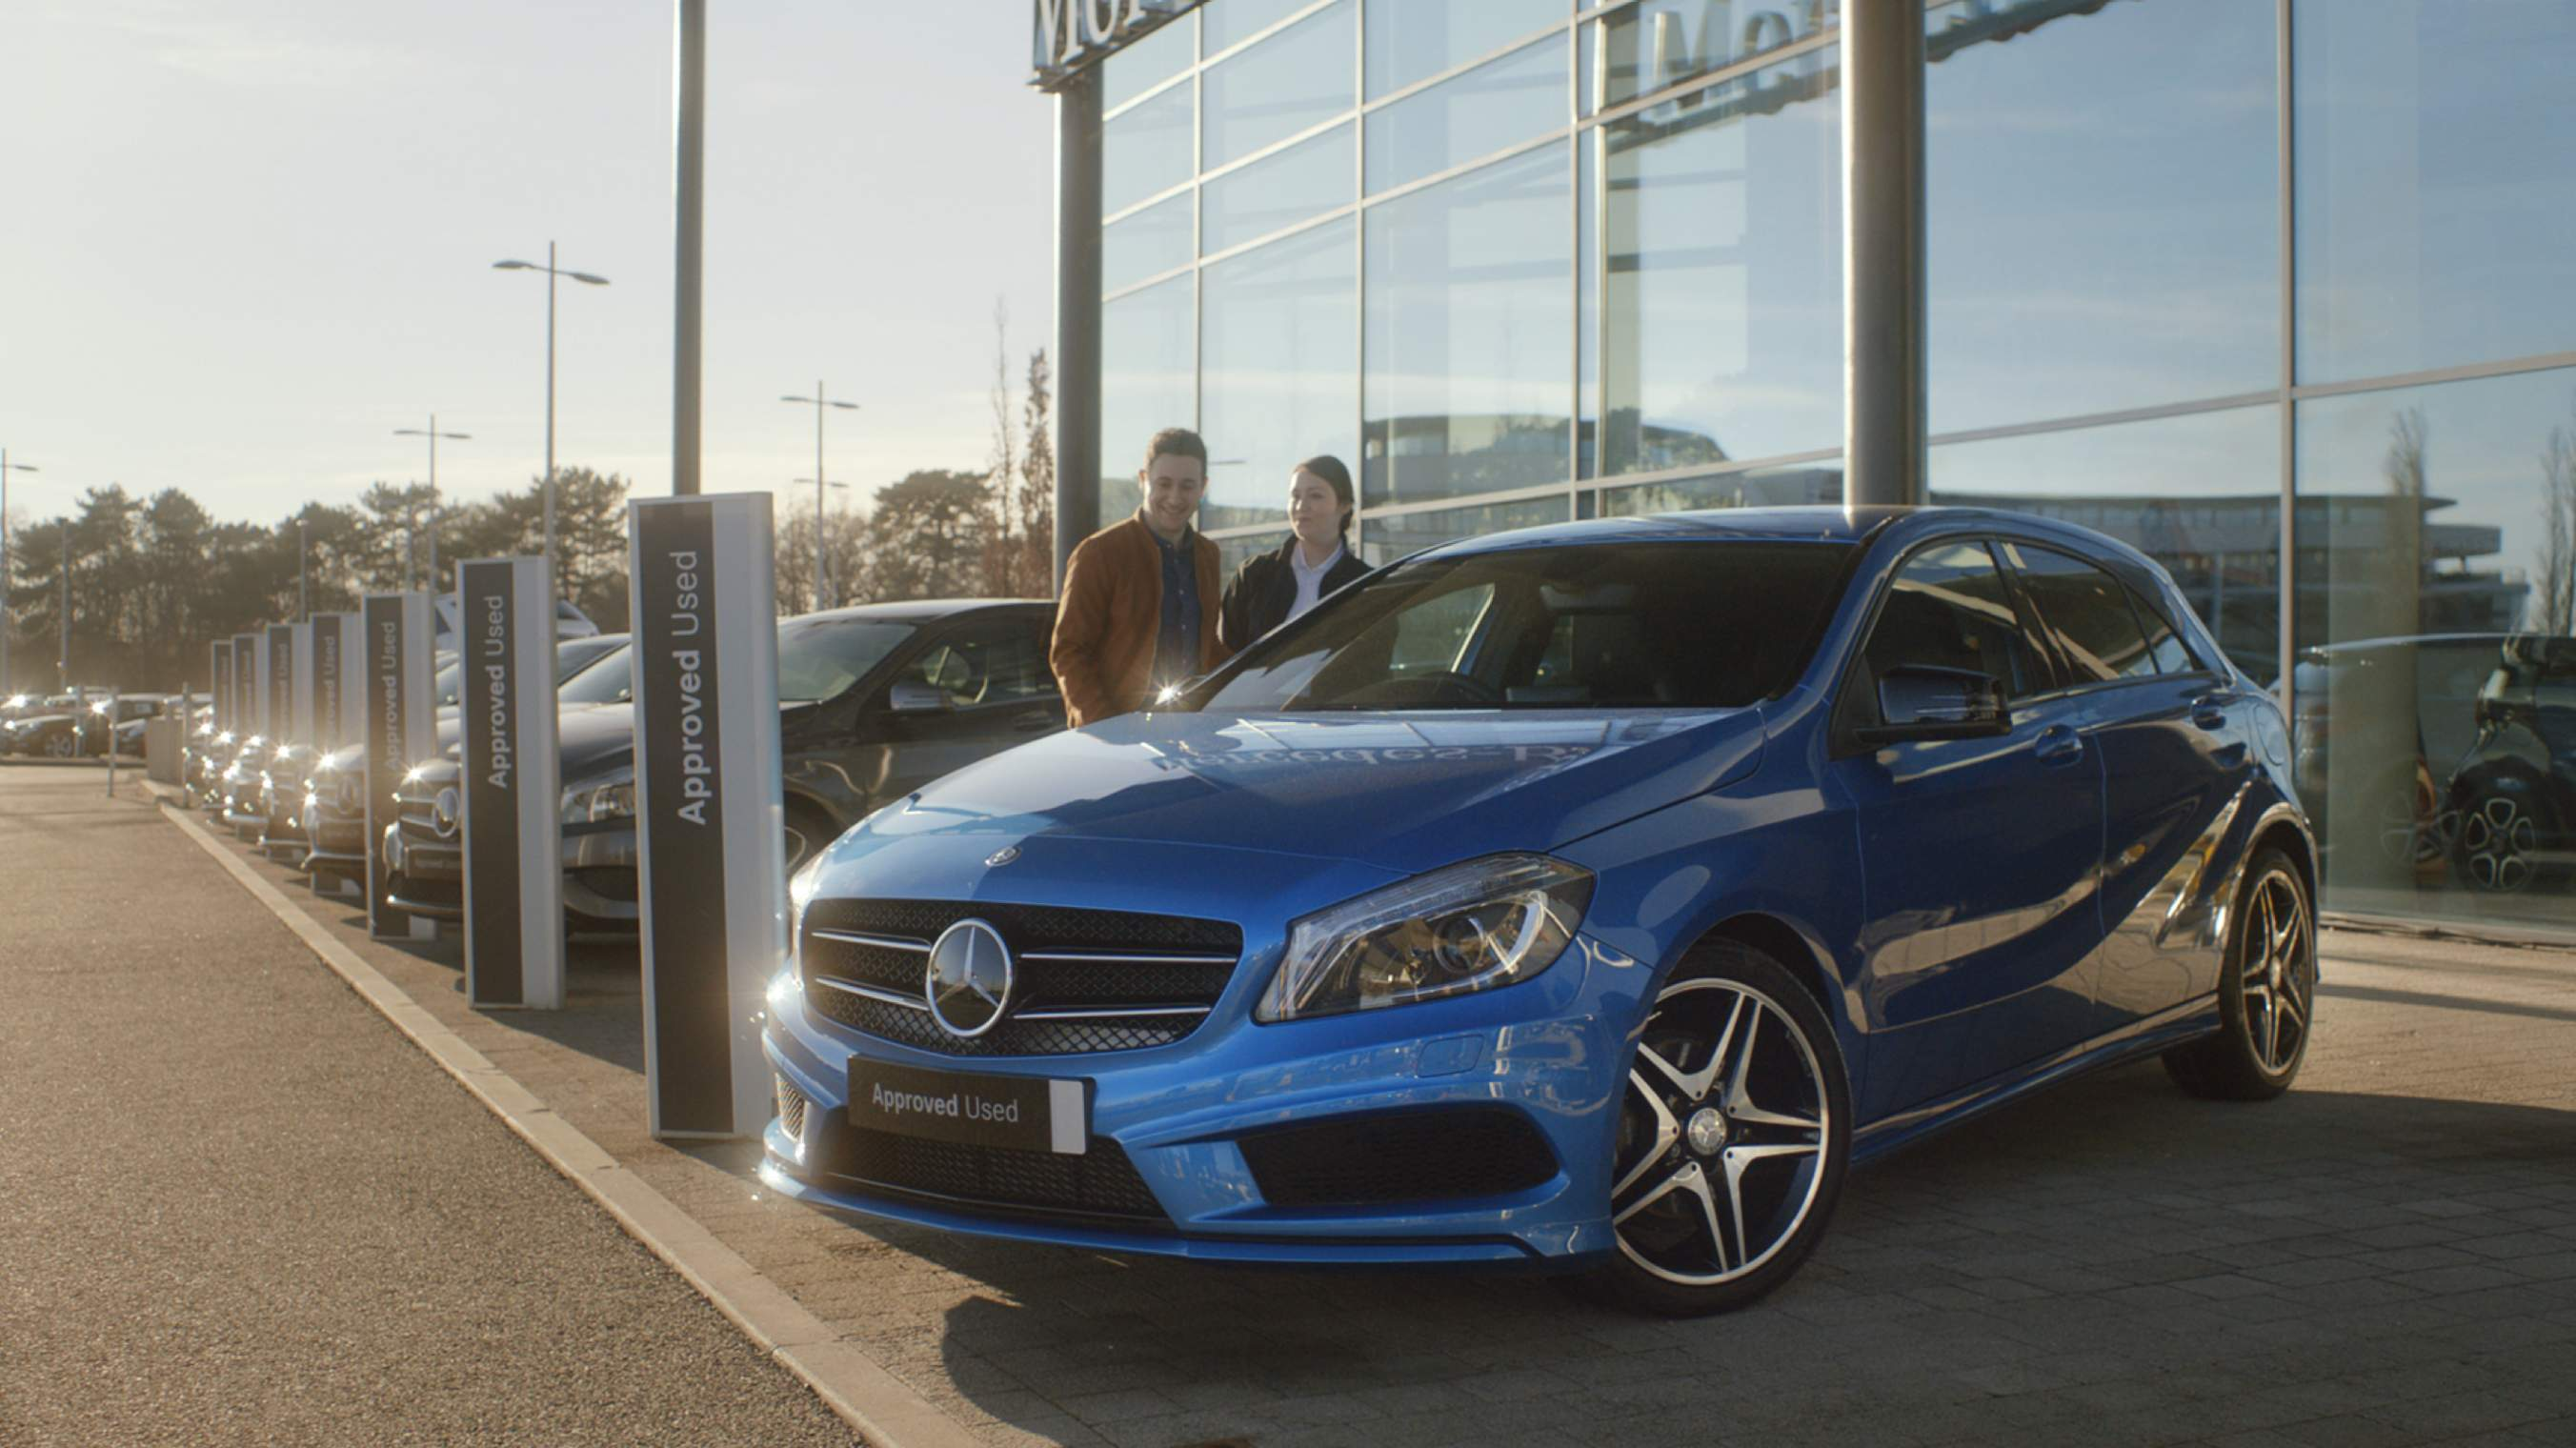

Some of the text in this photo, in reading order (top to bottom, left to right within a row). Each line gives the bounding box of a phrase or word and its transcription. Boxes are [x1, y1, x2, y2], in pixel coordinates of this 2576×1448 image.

[382, 621, 398, 670] Used
[483, 595, 512, 789] Approved Used
[669, 552, 713, 826] Approved Used
[872, 1082, 1019, 1123] Approved Used
